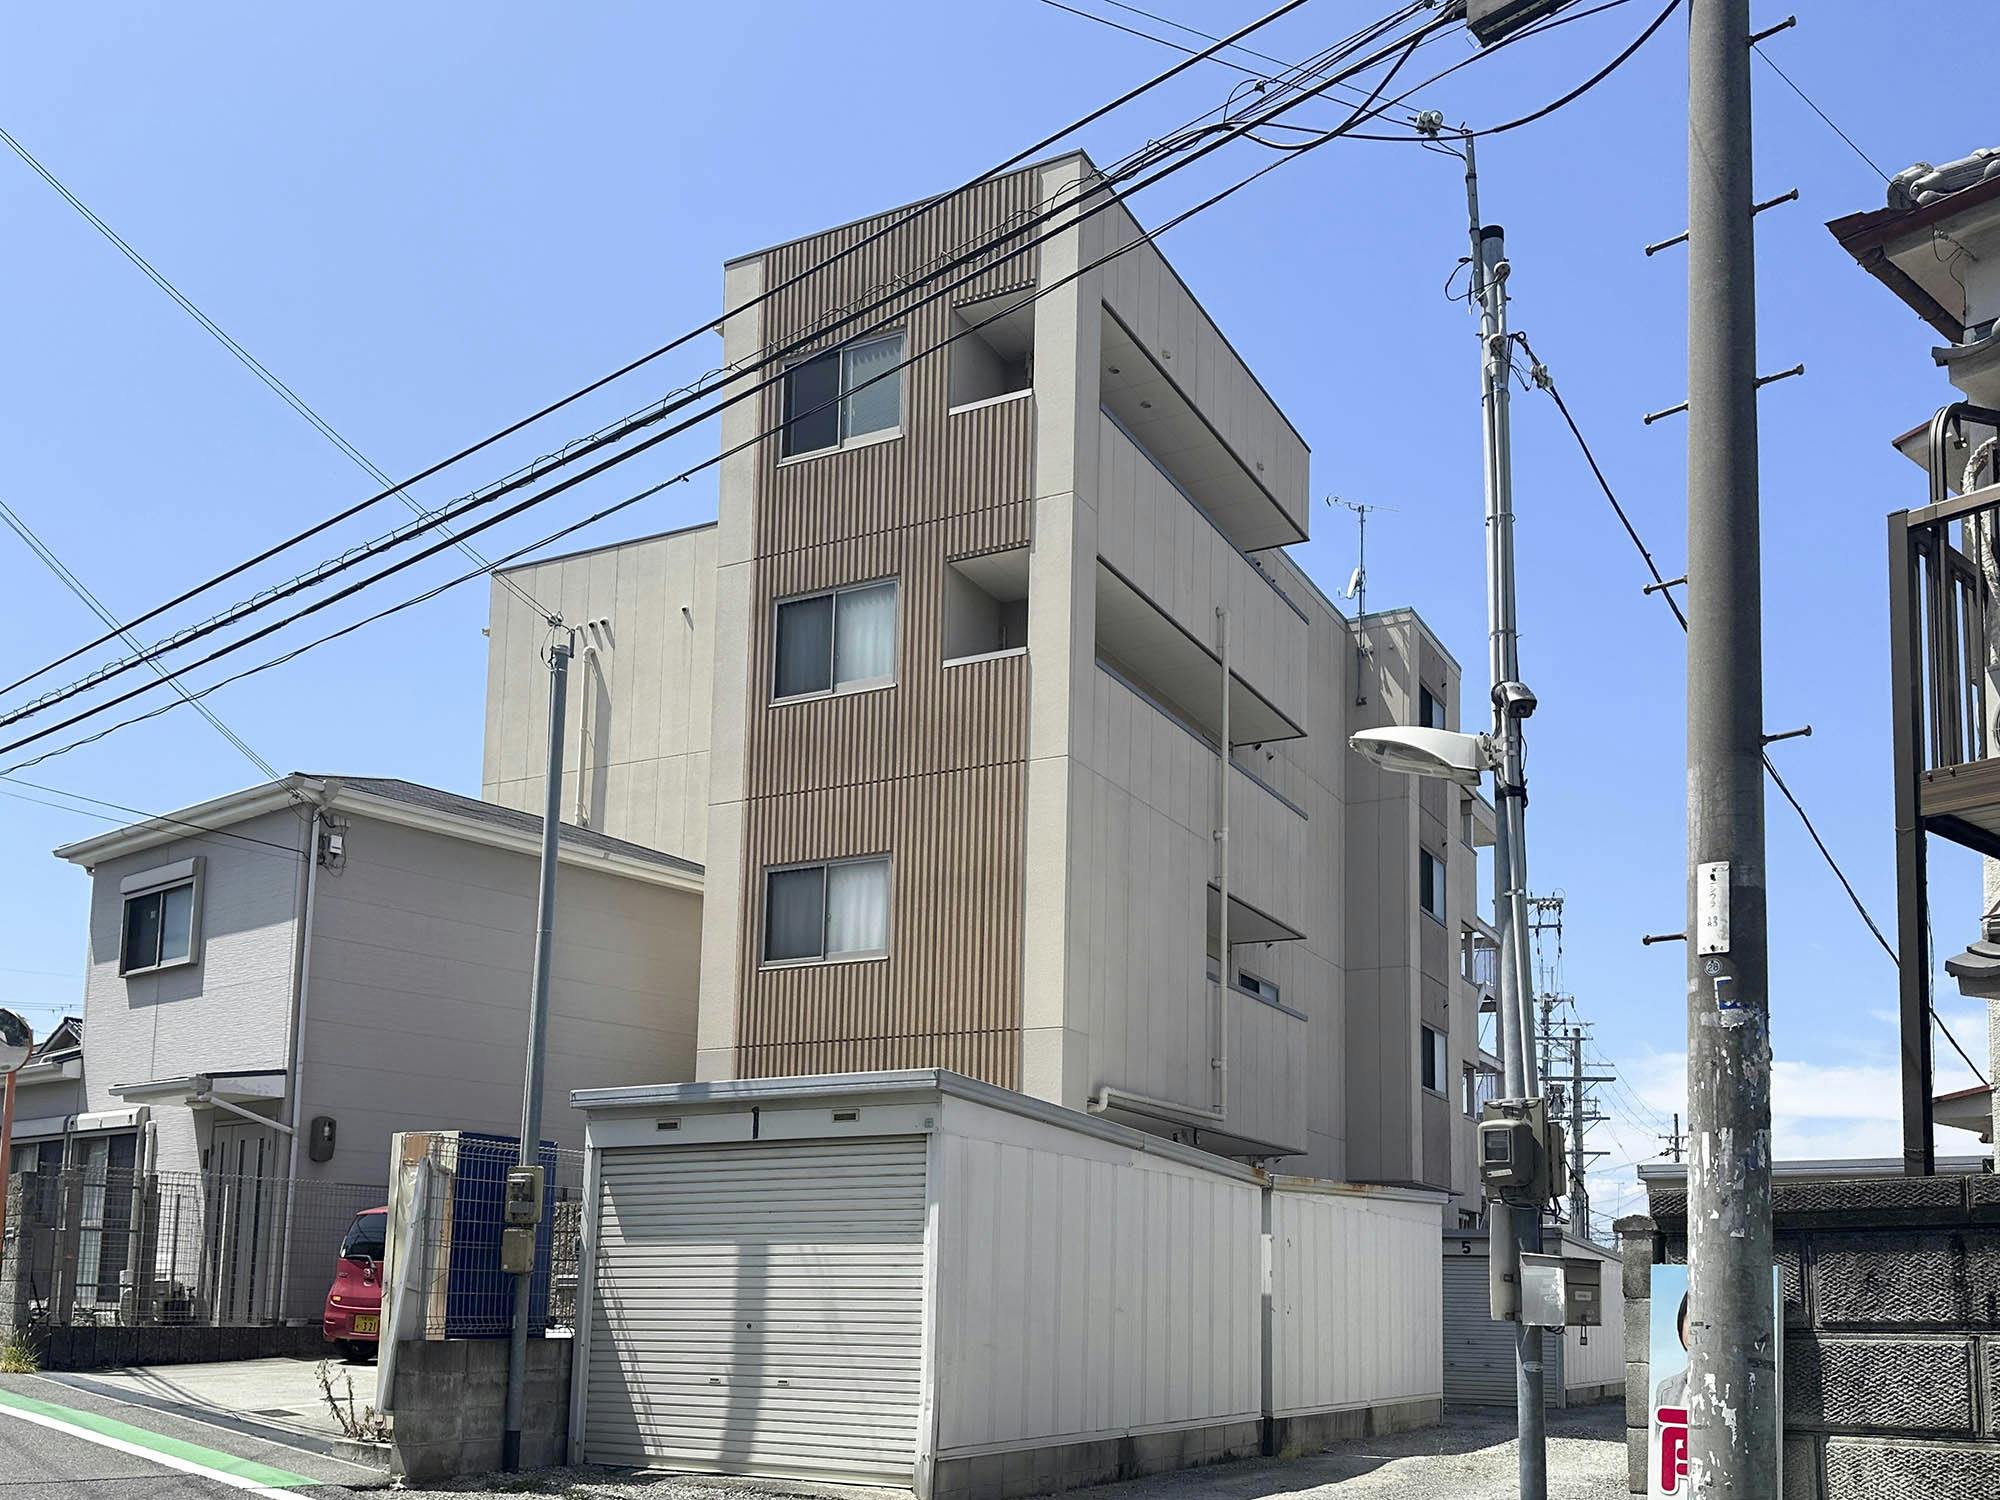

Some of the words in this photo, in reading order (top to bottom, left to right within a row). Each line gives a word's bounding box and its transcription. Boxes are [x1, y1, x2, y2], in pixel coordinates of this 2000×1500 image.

[1708, 962, 1719, 972] 28
[752, 1105, 760, 1140] 1
[1461, 1240, 1472, 1255] 5
[362, 1321, 377, 1332] 321
